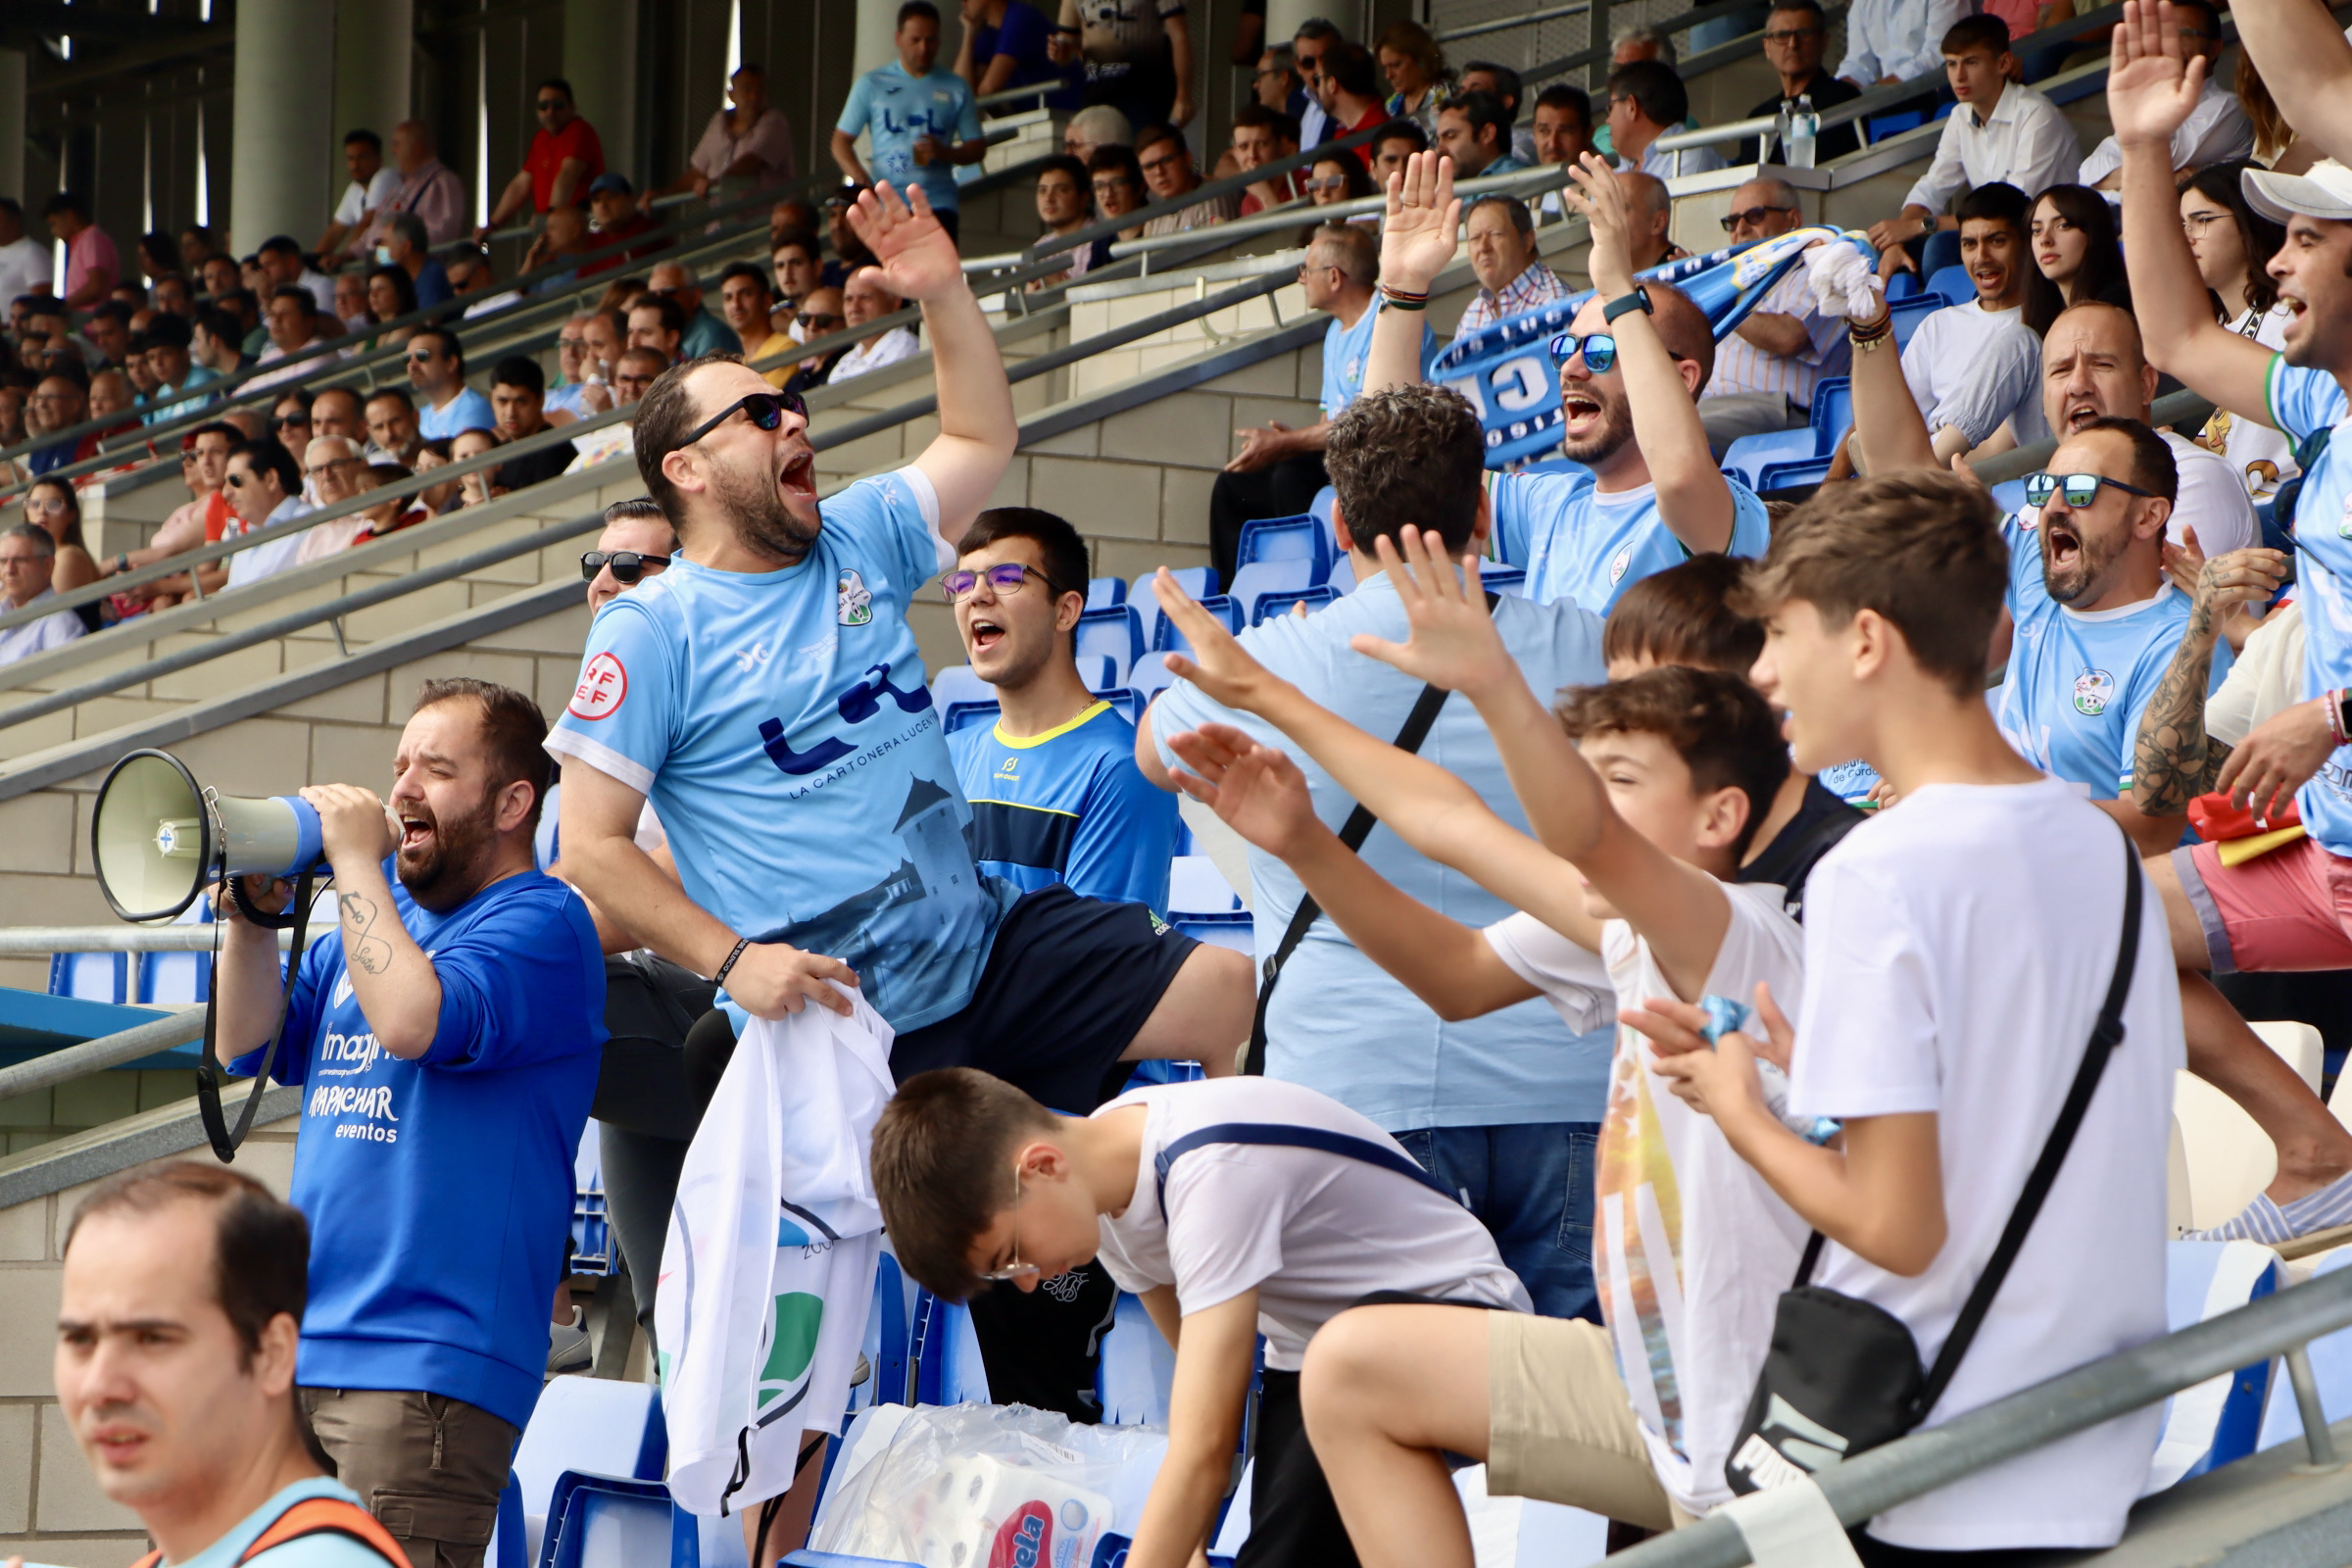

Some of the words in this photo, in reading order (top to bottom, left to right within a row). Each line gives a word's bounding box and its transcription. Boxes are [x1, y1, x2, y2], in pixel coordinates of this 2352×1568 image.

[789, 786, 810, 800] LA
[812, 737, 902, 789] CARTONERA
[335, 1122, 398, 1144] eventos
[1010, 1514, 1046, 1568] ela
